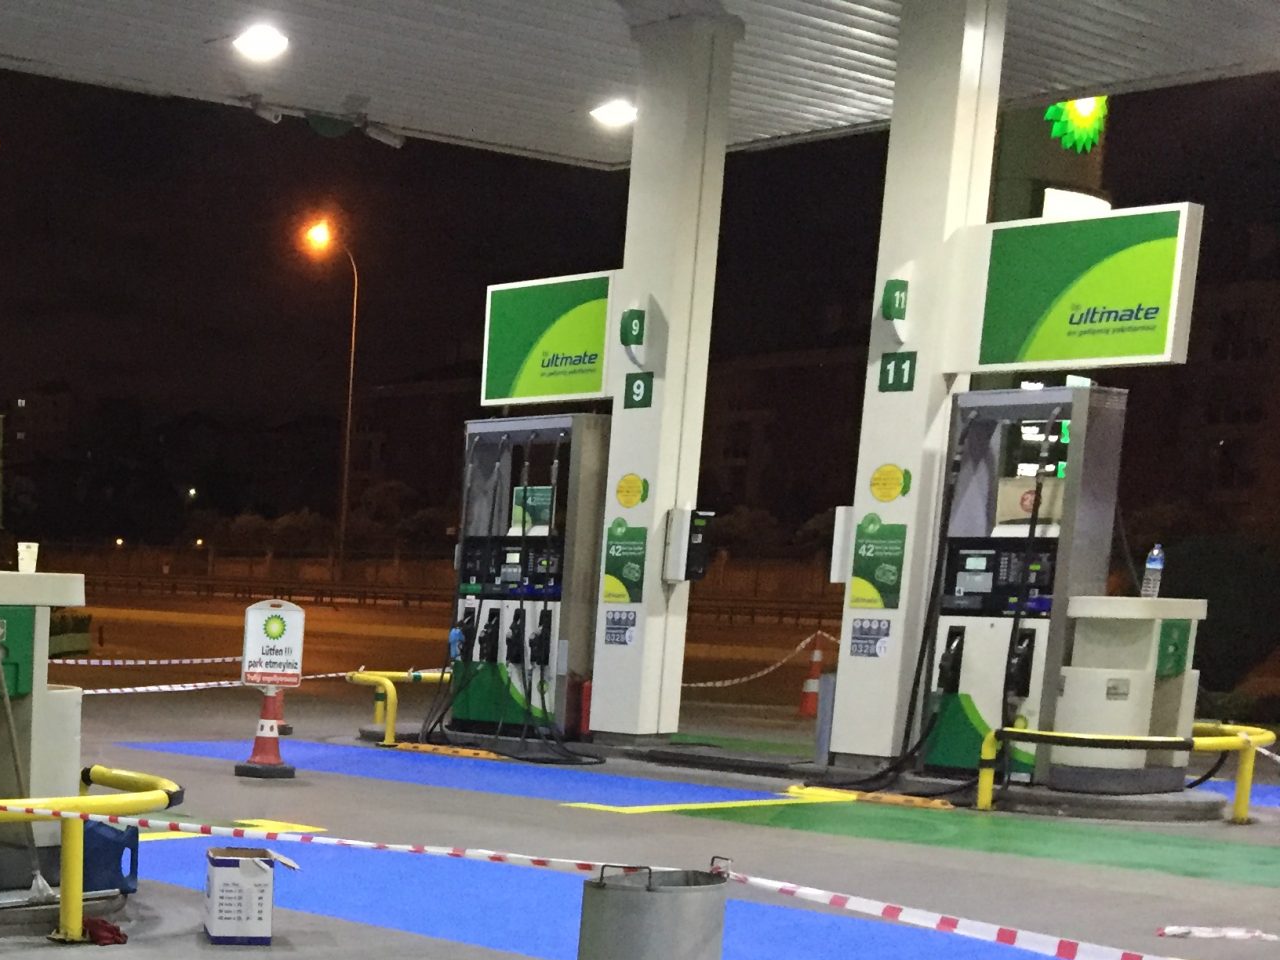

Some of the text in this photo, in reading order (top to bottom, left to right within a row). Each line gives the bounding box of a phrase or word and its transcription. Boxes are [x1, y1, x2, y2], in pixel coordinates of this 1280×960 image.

[894, 290, 906, 309] 11
[1068, 303, 1160, 326] ultimate
[631, 319, 640, 336] 9
[540, 351, 599, 369] ultimate
[886, 360, 911, 385] 11
[632, 379, 645, 402] 9
[608, 545, 623, 557] 42
[858, 544, 875, 557] 42
[261, 645, 283, 656] Lütfen
[248, 658, 263, 670] park
